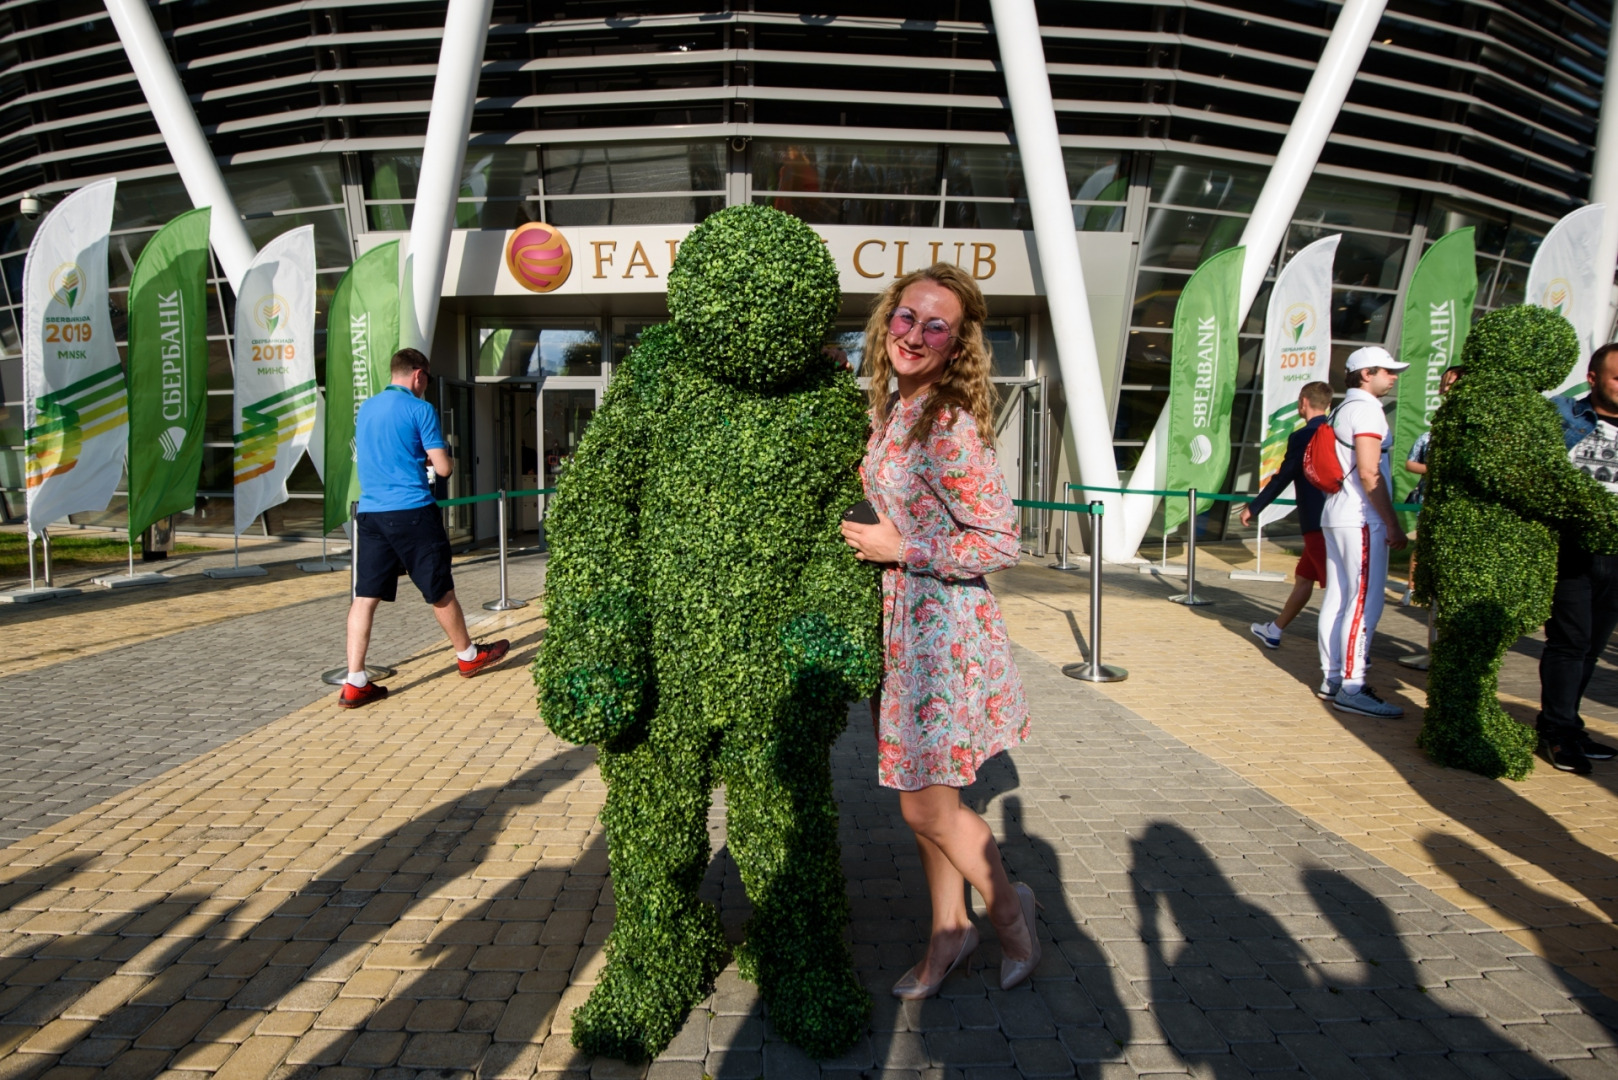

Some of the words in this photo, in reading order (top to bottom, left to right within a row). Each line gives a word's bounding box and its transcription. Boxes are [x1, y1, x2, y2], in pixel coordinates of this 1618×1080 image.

[853, 239, 997, 280] CLUB
[45, 323, 92, 343] 2019
[158, 290, 182, 421] СБЕРБАНК
[251, 345, 295, 361] 2019
[1280, 352, 1316, 369] 2019
[257, 366, 289, 375] МИНСК
[351, 312, 368, 426] ERBANK
[1193, 315, 1216, 428] SBERBANK
